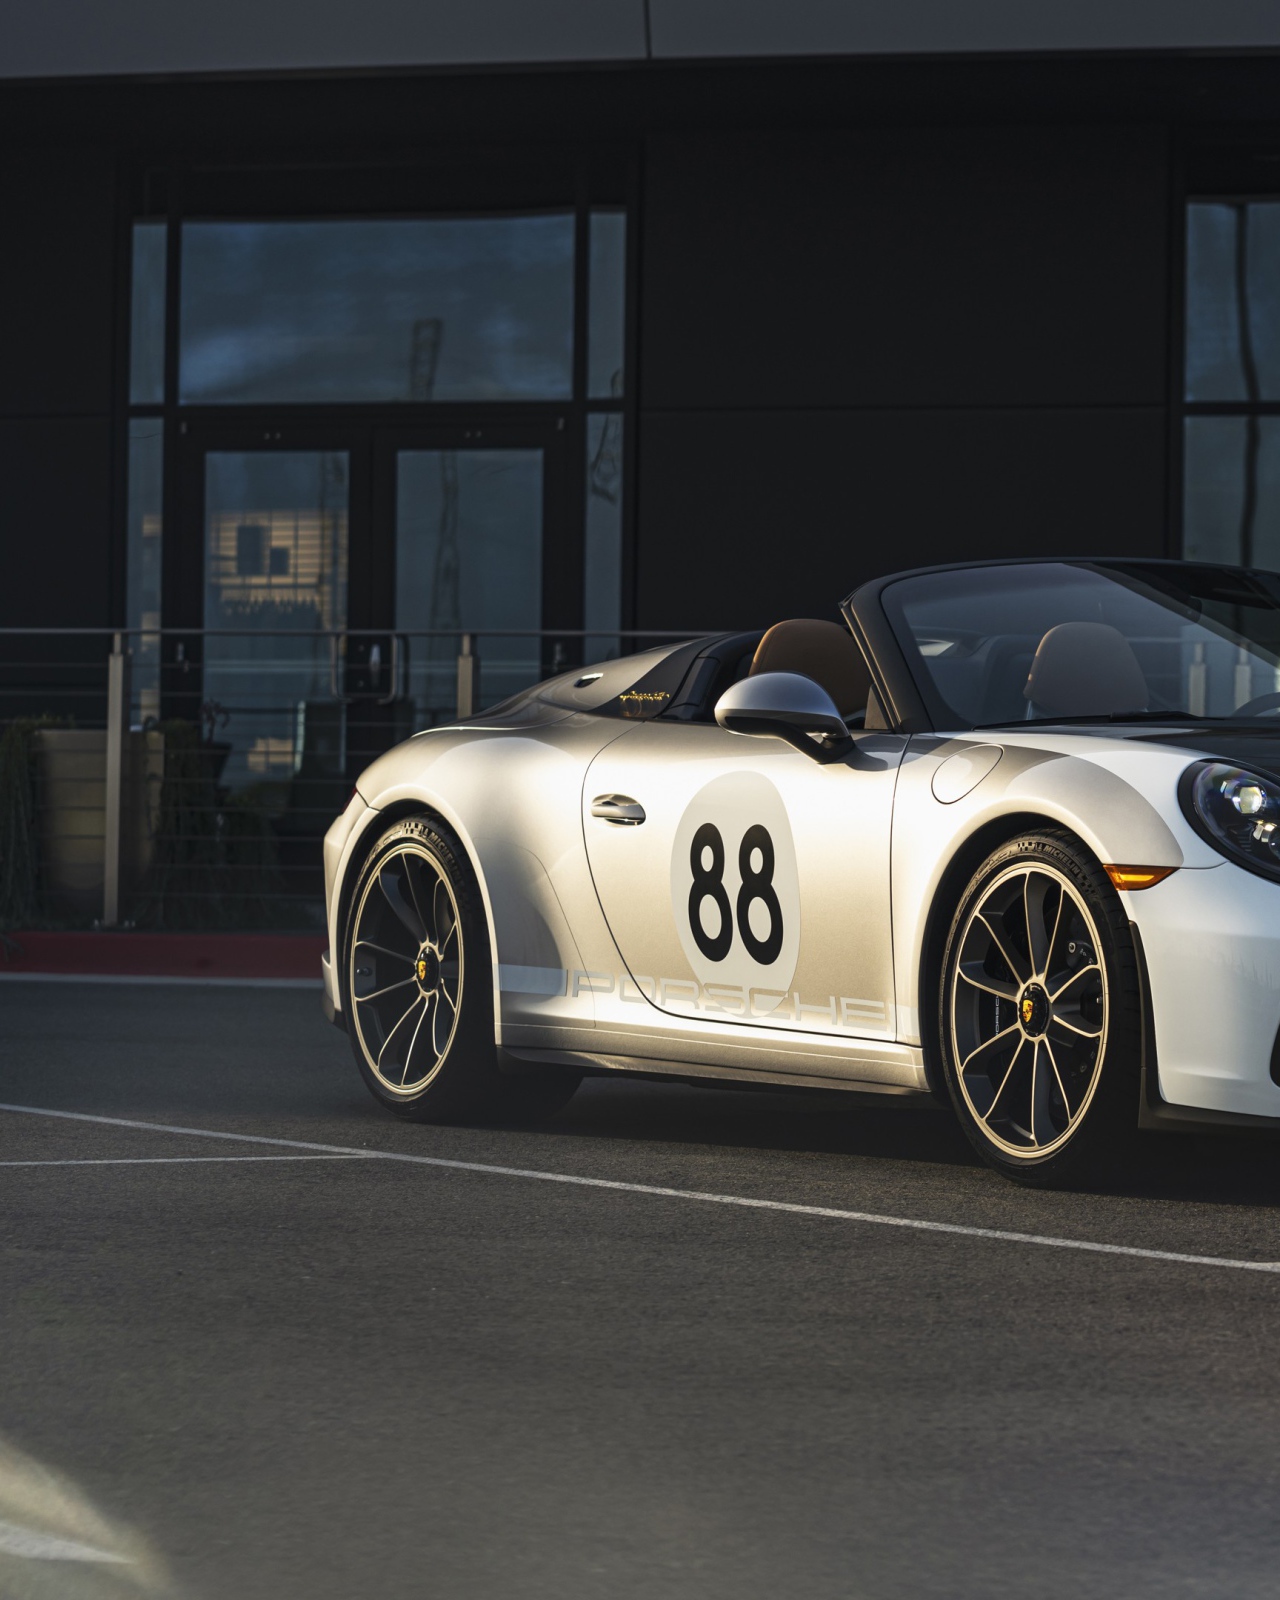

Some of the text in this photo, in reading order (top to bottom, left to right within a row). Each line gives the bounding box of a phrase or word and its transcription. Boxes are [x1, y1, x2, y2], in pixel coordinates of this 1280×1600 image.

[1043, 845, 1080, 876] MICHELIN
[688, 822, 784, 965] 88
[572, 969, 888, 1031] PORSCHE
